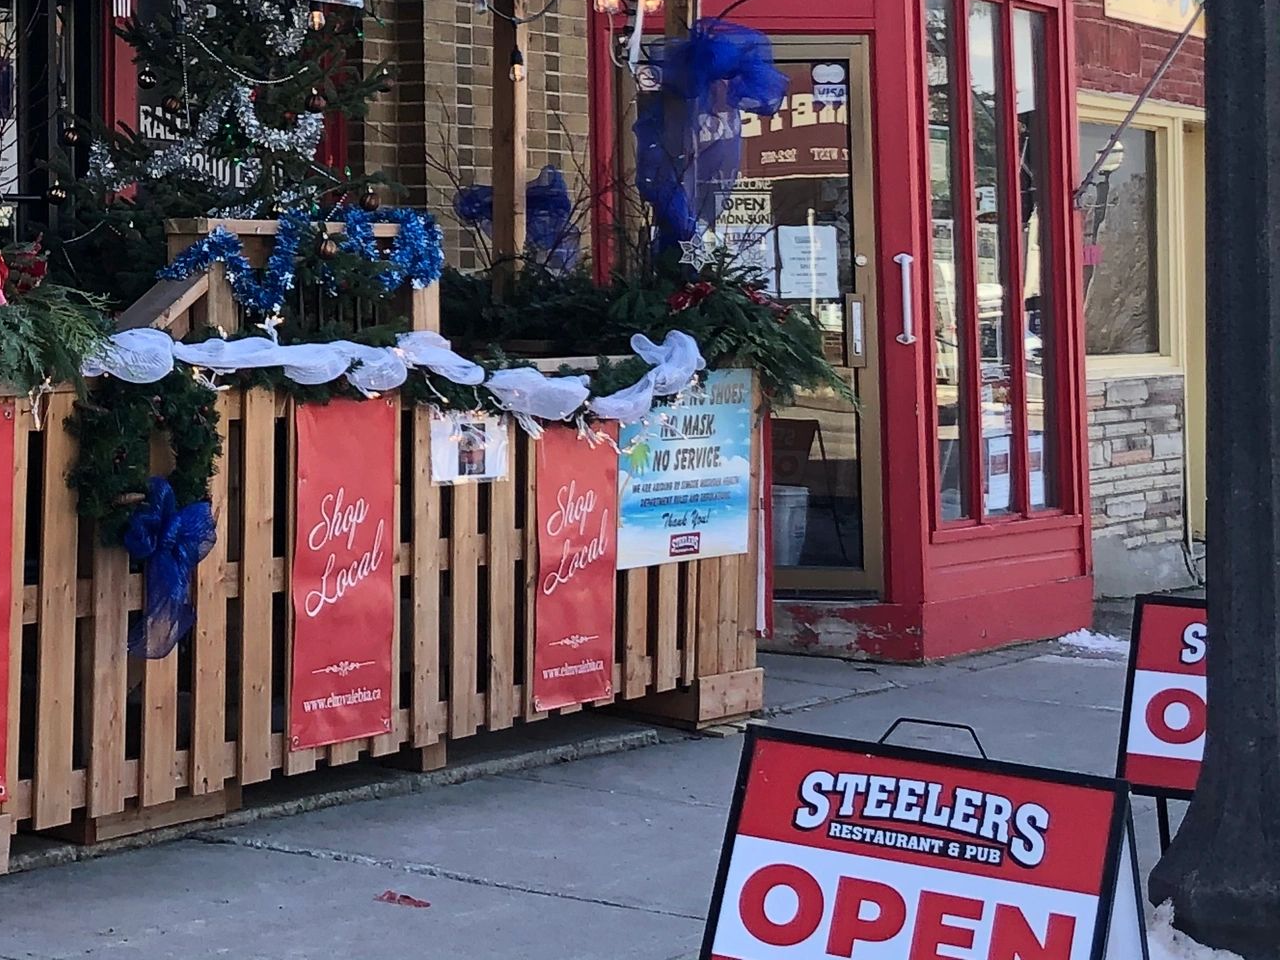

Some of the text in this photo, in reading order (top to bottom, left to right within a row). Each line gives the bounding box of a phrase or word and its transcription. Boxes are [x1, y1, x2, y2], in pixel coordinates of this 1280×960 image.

[818, 87, 845, 98] VISA
[716, 214, 770, 225] MON-SUN
[722, 197, 766, 211] OPEN
[652, 449, 670, 472] NO
[307, 486, 369, 552] Shop
[546, 480, 597, 537] Shop
[662, 510, 688, 529] Thank
[305, 519, 384, 618] Local
[543, 509, 608, 595] Local
[794, 770, 1051, 867] STEELERS
[828, 822, 1002, 864] RESTAURANT & PUB
[738, 862, 1077, 960] OPEN
